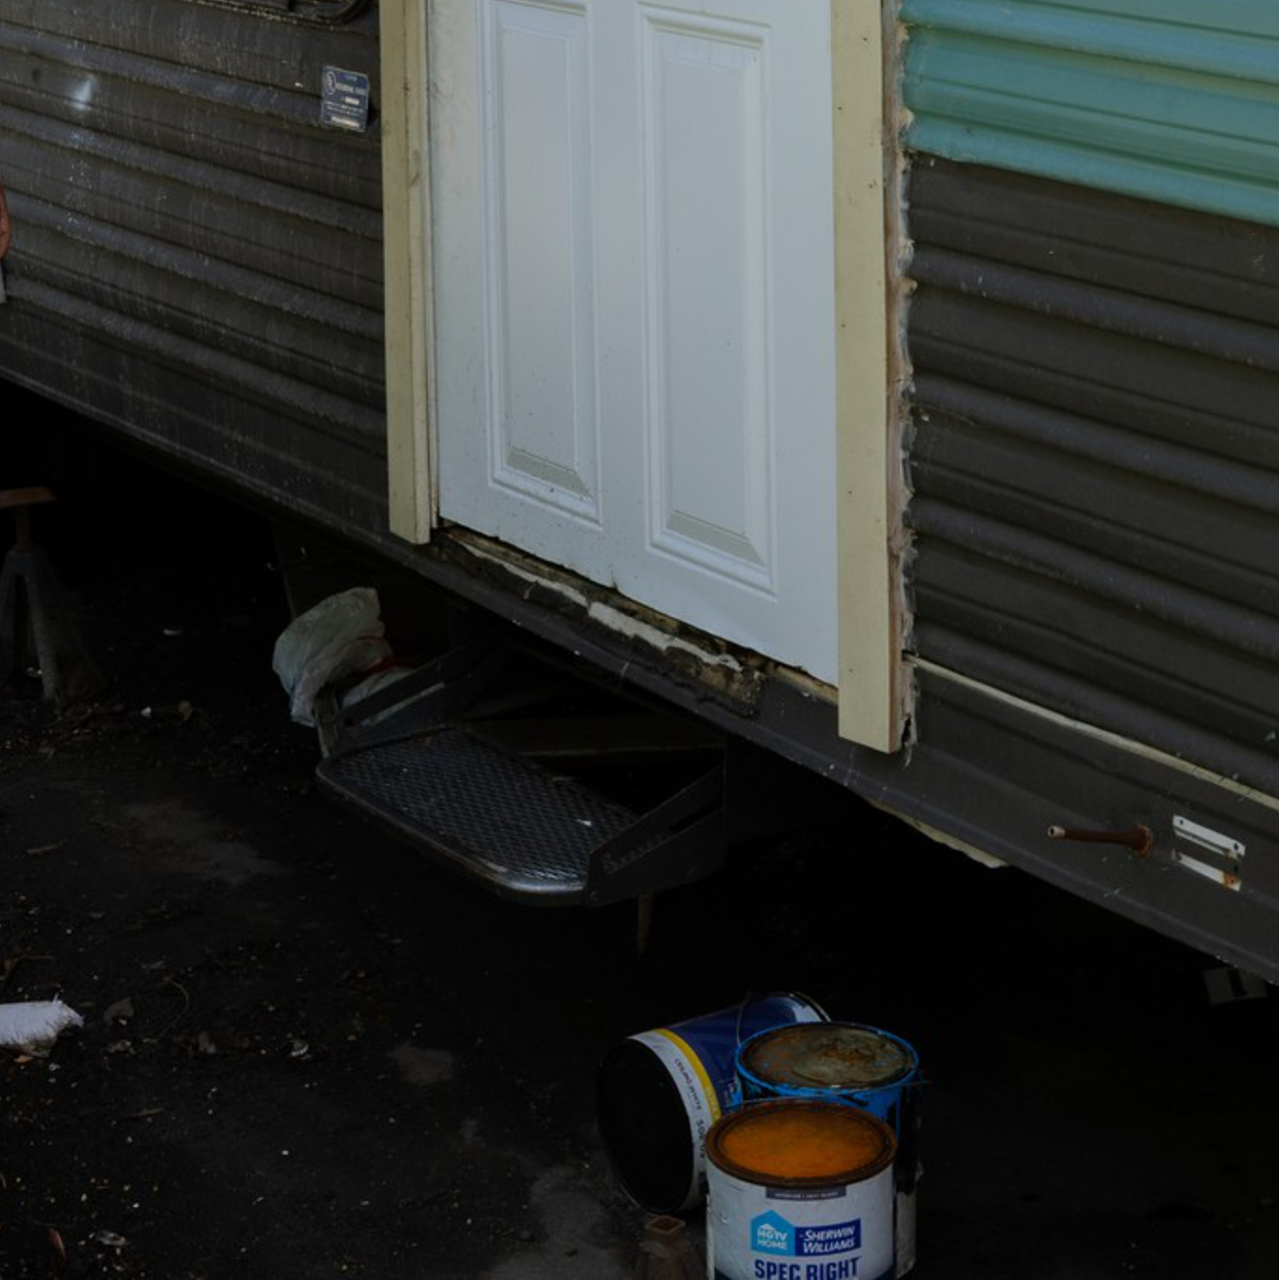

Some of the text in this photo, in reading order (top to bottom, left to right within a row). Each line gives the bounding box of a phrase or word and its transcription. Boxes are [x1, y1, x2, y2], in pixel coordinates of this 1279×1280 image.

[757, 1224, 788, 1242] HGTV
[757, 1239, 788, 1251] HOME
[803, 1238, 855, 1254] WILLIAMS
[754, 1256, 862, 1280] SPEC RIGHT
